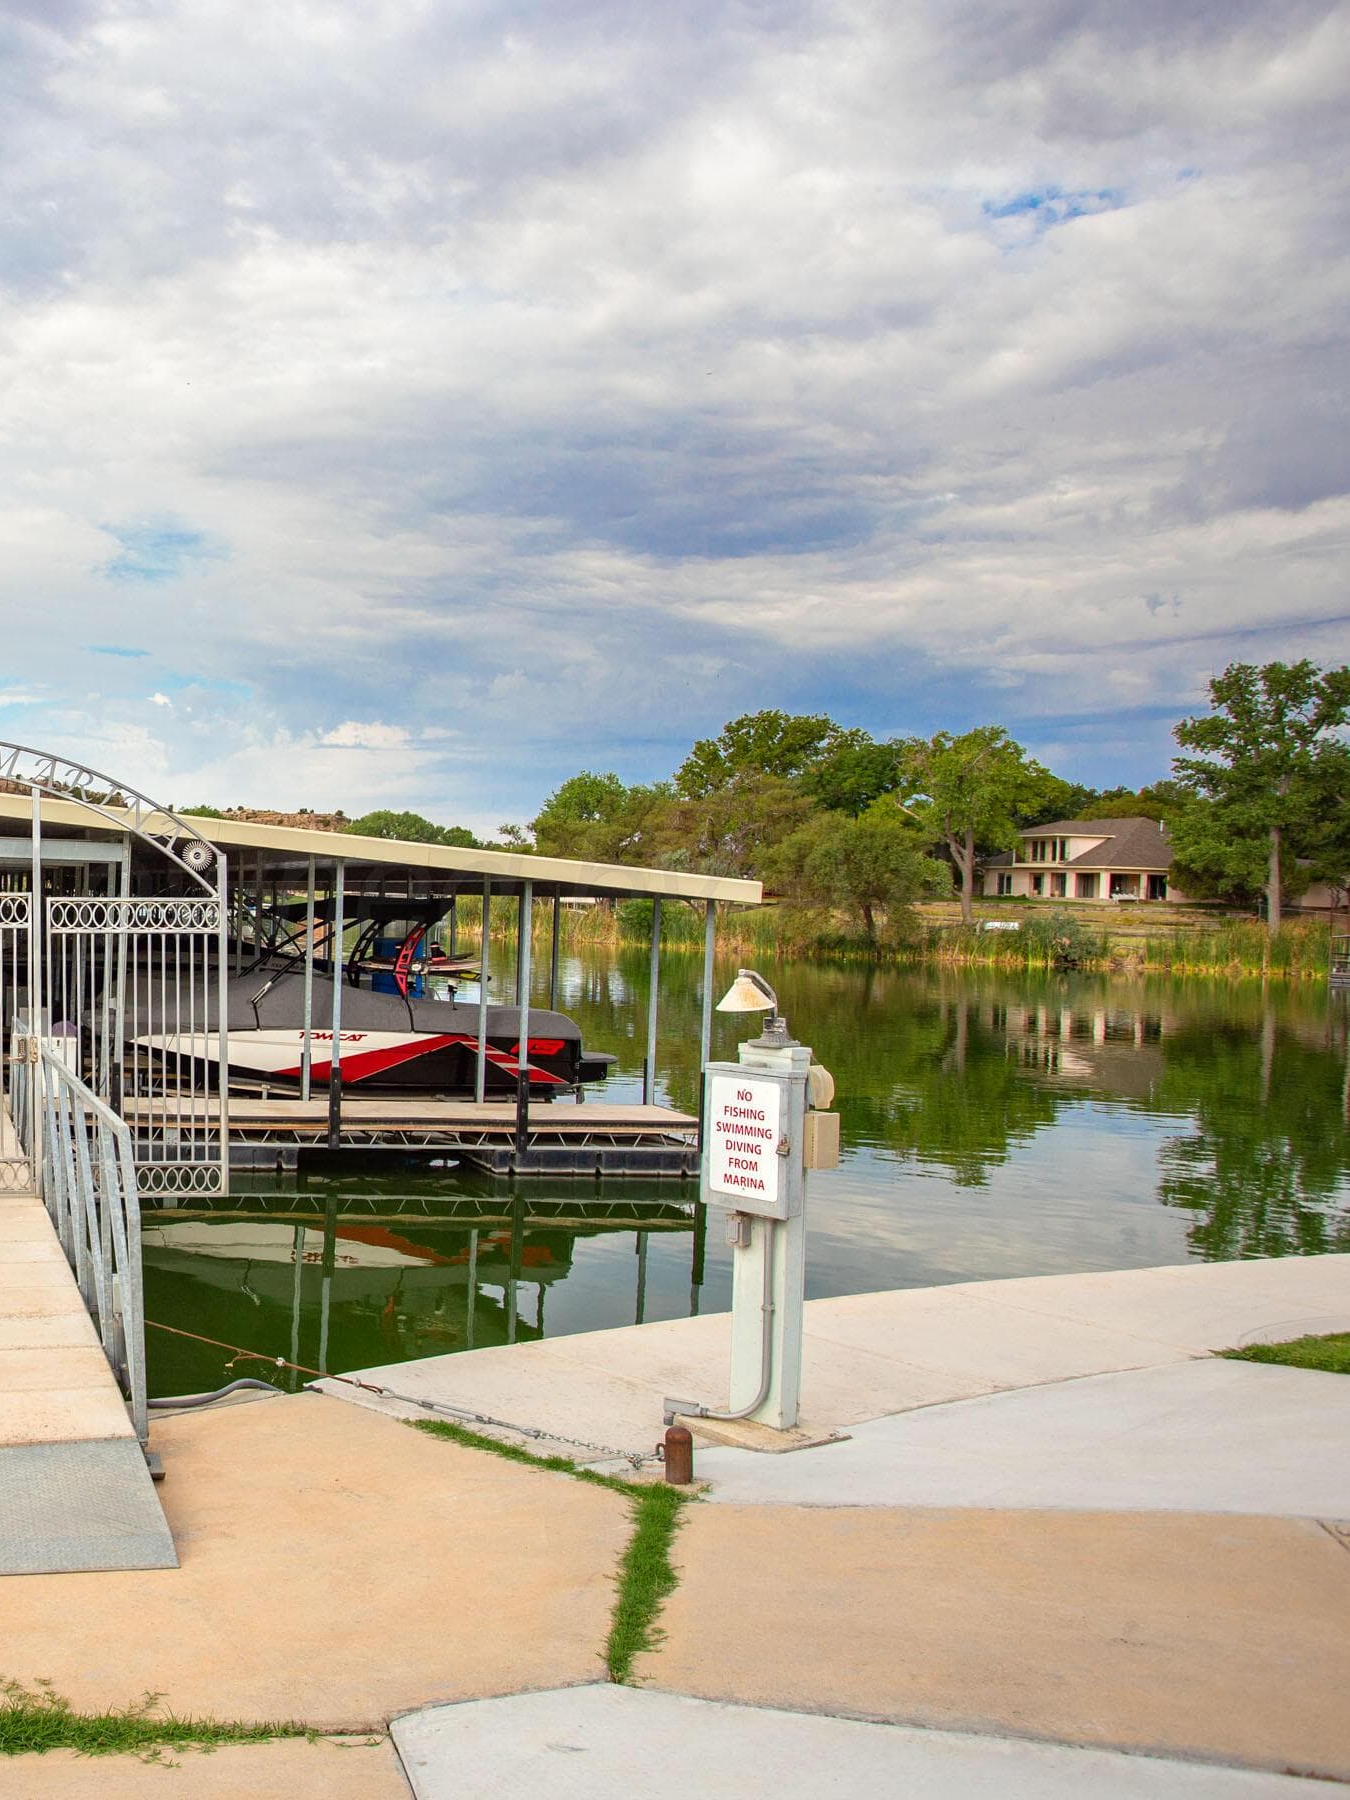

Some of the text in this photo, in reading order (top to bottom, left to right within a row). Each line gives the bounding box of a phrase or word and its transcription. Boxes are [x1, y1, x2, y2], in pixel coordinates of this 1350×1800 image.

[737, 1090, 753, 1102] NO
[723, 1105, 765, 1121] FISHING
[716, 1121, 773, 1140] SWIMMING
[725, 1139, 762, 1155] DIVING
[728, 1157, 758, 1172] FROM
[723, 1173, 765, 1191] MARINA
